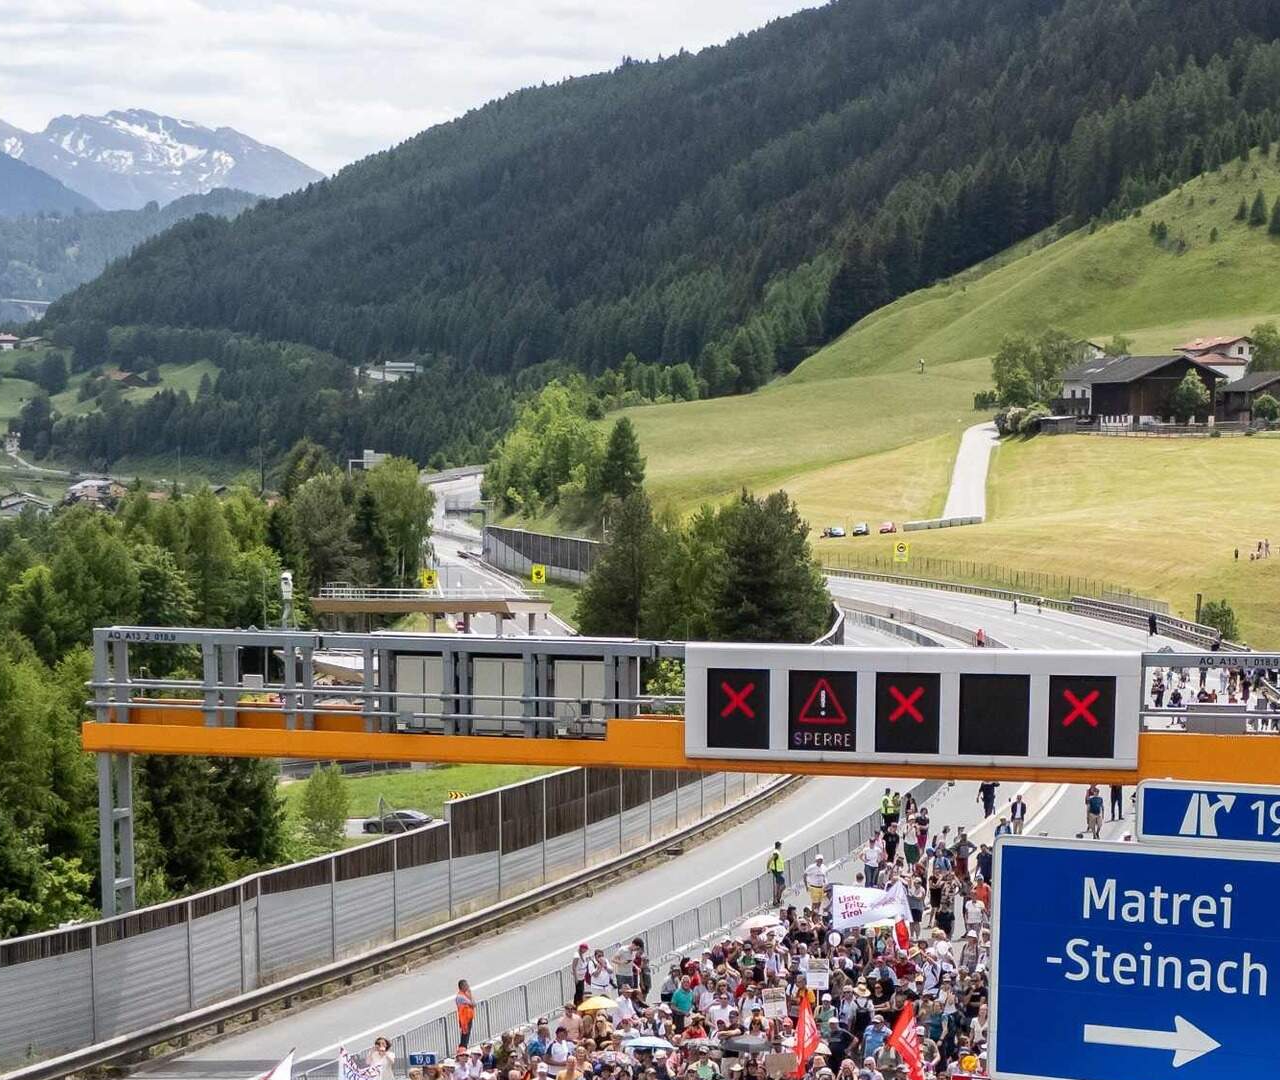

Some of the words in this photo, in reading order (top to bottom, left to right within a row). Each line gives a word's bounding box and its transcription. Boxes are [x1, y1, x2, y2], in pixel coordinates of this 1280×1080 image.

[794, 731, 851, 747] SPERRE
[840, 909, 862, 920] Tirol
[1082, 876, 1233, 929] Matrei
[1046, 938, 1268, 996] -Steinach
